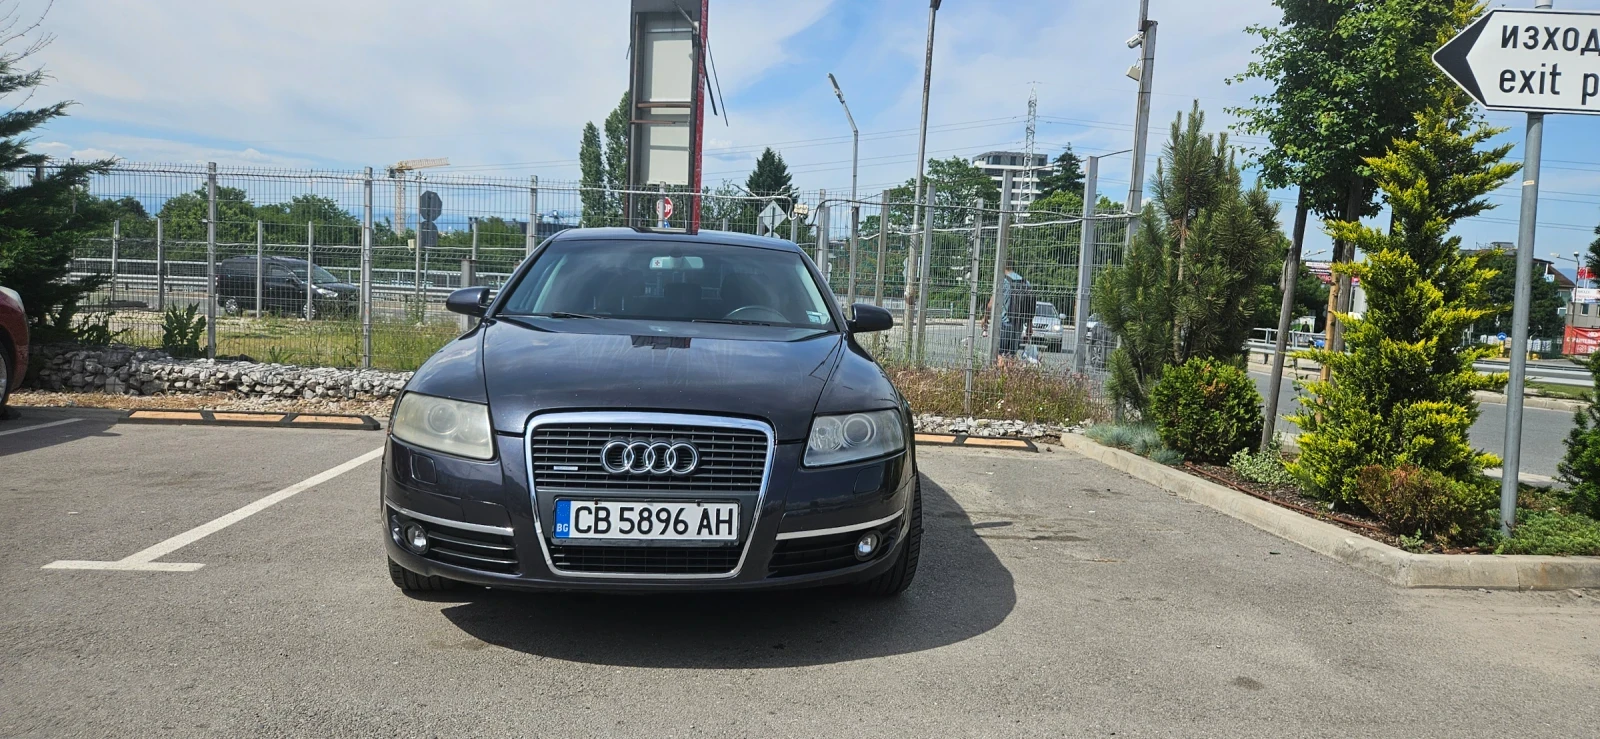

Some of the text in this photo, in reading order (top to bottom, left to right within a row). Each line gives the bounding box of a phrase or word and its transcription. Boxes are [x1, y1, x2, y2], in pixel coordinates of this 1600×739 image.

[1499, 63, 1561, 95] exit
[556, 523, 569, 532] BG
[574, 506, 733, 535] CB 5896 AH
